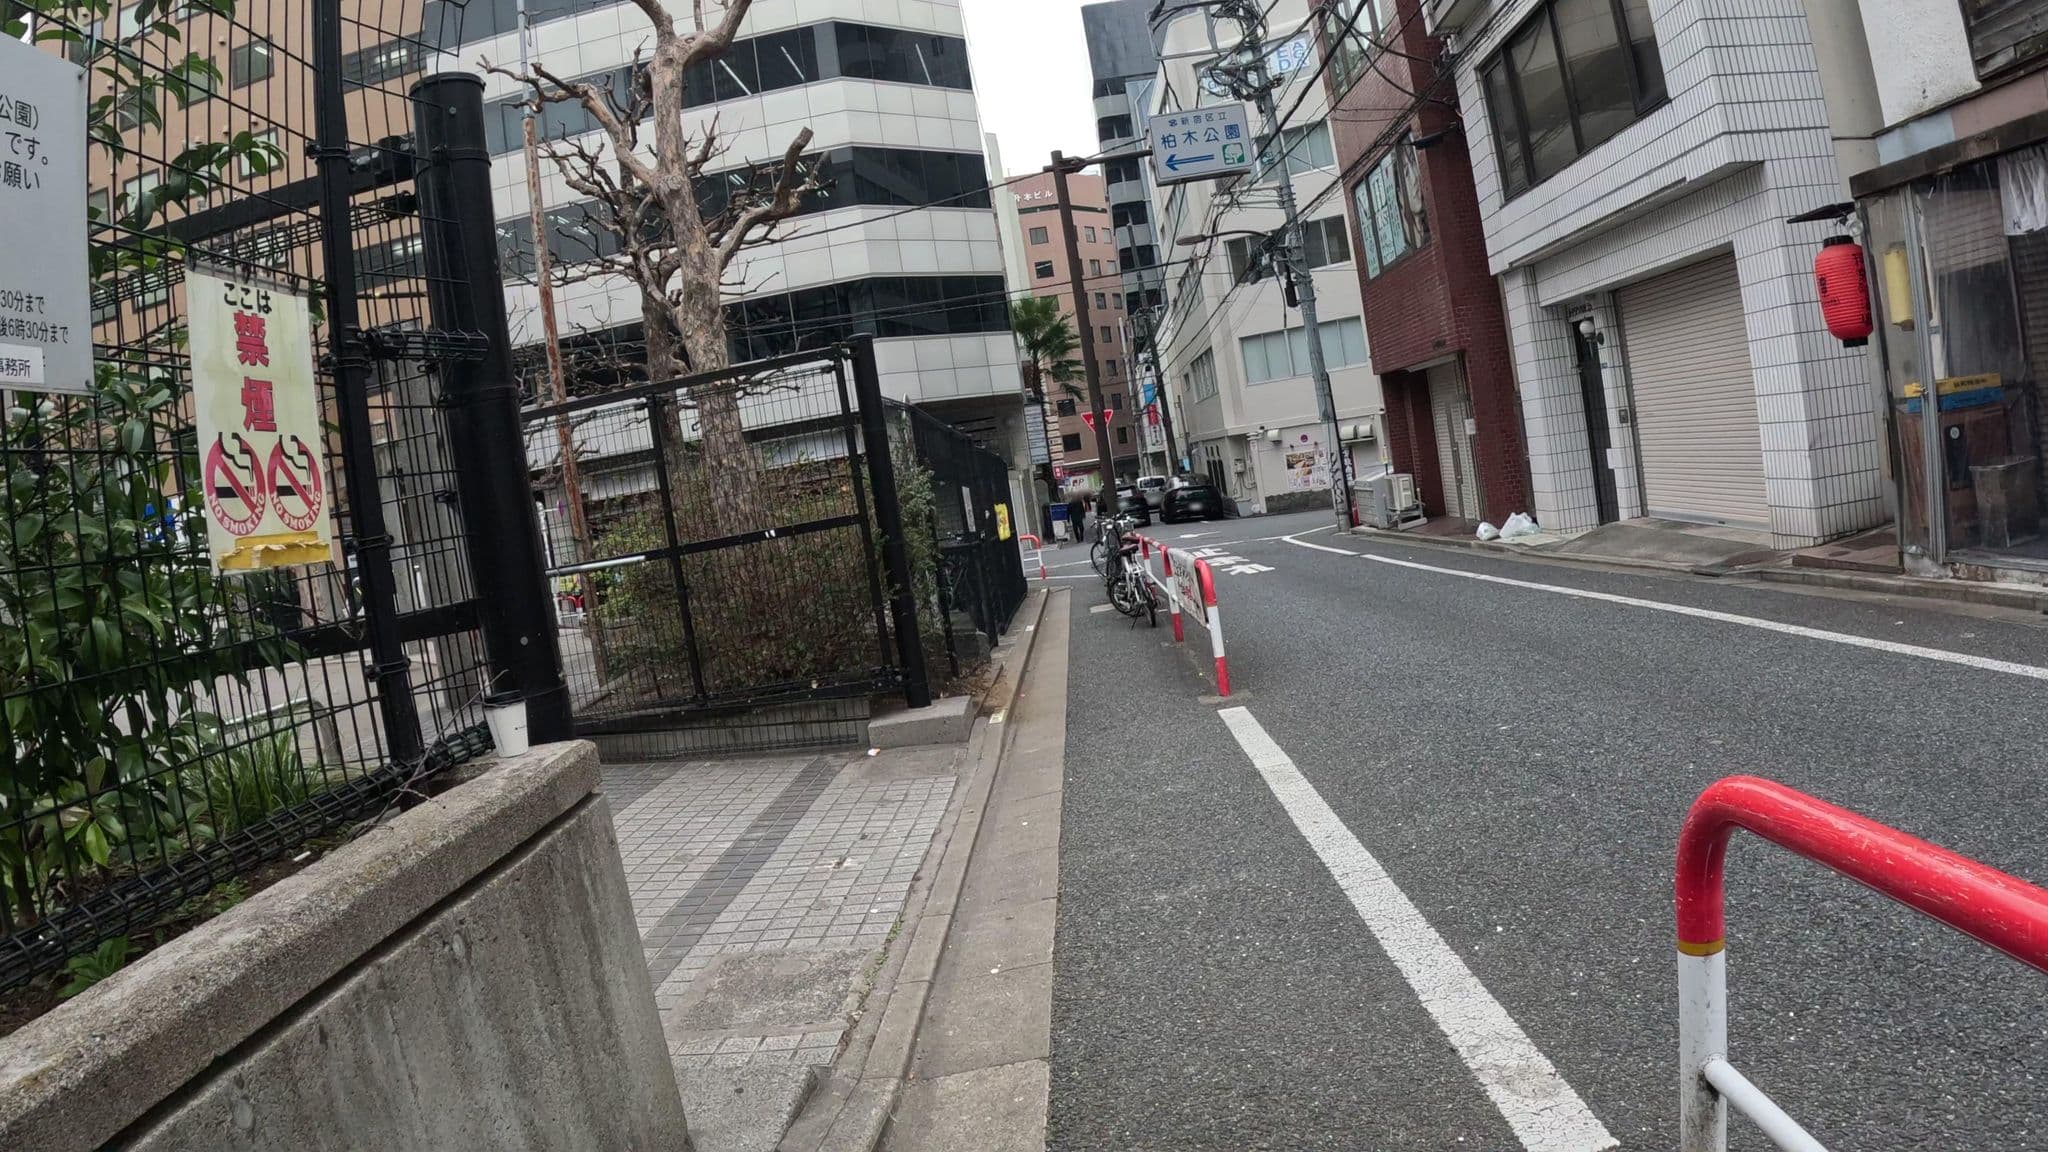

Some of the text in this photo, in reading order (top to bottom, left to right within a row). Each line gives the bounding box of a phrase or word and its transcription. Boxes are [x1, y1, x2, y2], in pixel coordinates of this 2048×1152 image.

[5, 131, 48, 166] です。
[1160, 123, 1241, 150] 柏木公園
[0, 161, 41, 190] 願い
[223, 282, 272, 314] ここは
[233, 310, 277, 432] 禁煙
[208, 492, 265, 535] NO SMOKING
[270, 491, 321, 530] NO SMOKING
